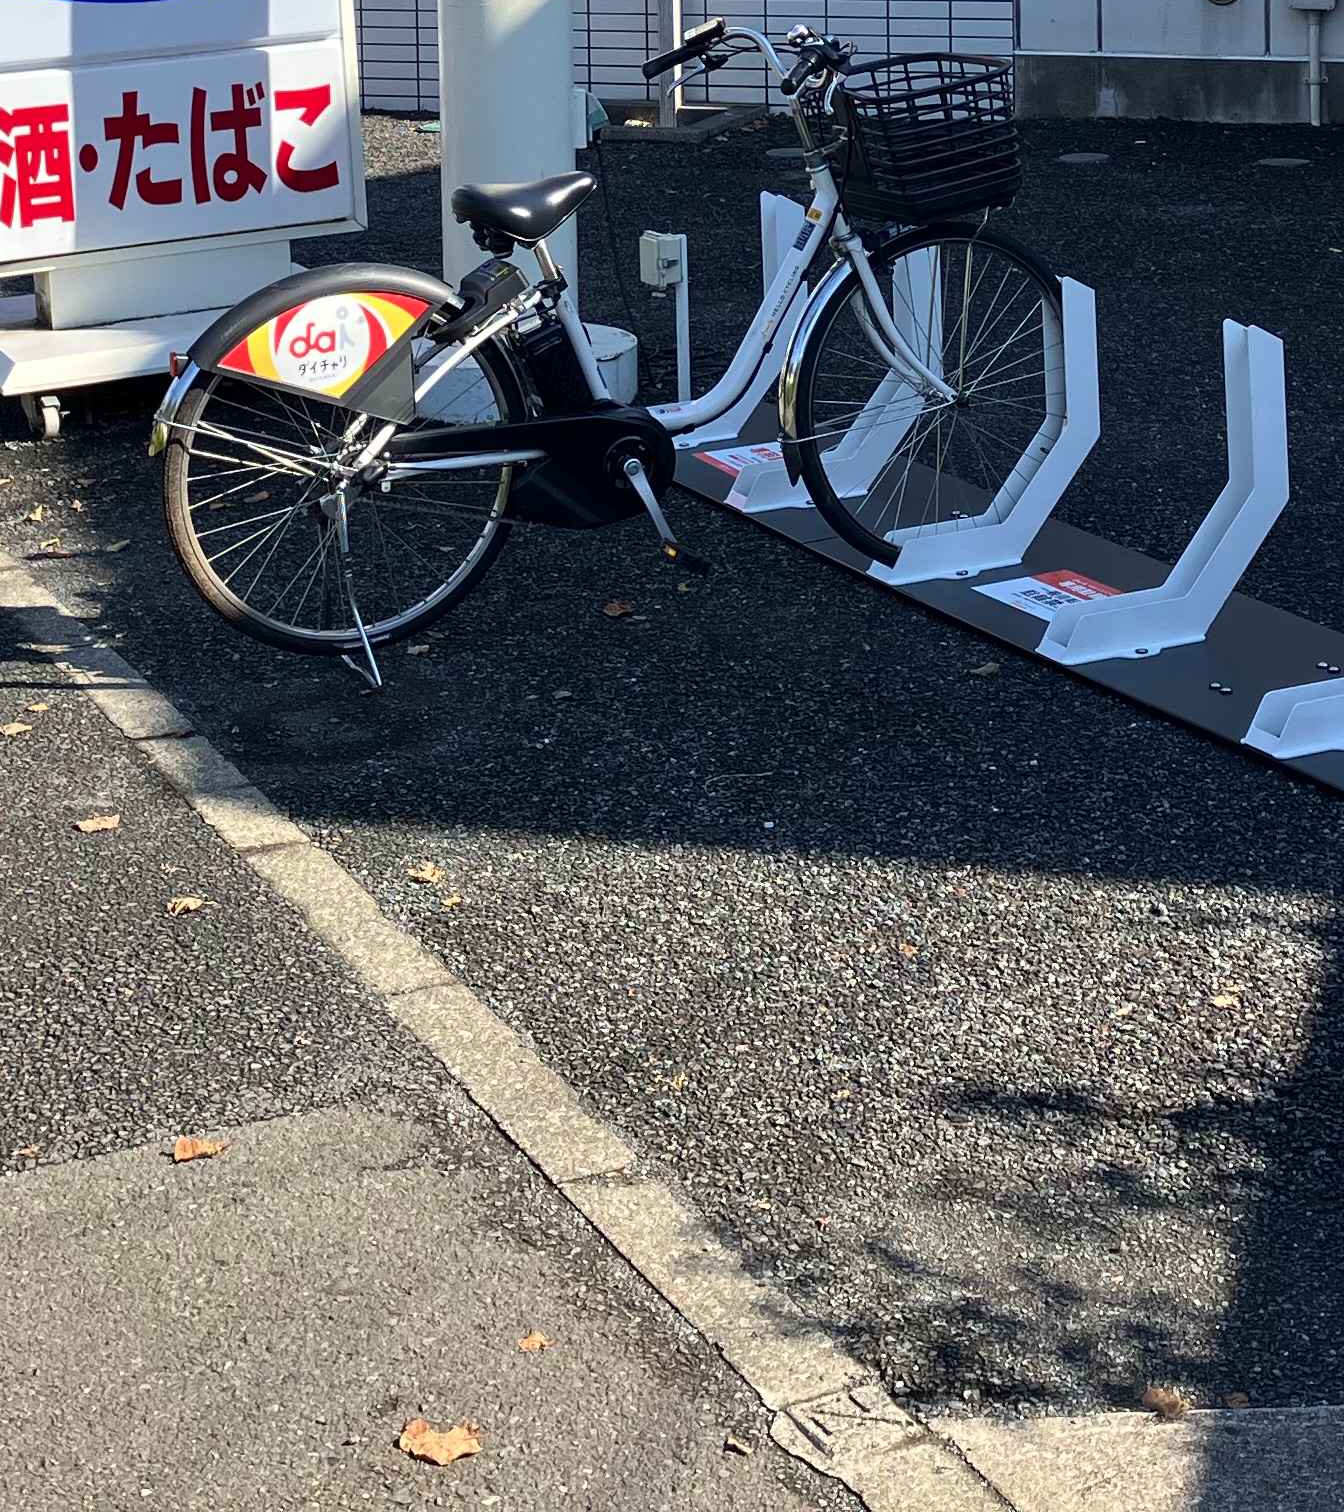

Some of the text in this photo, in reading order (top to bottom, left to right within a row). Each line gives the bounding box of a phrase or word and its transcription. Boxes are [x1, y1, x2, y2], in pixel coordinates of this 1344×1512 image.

[297, 354, 348, 377] ダイチャリ
